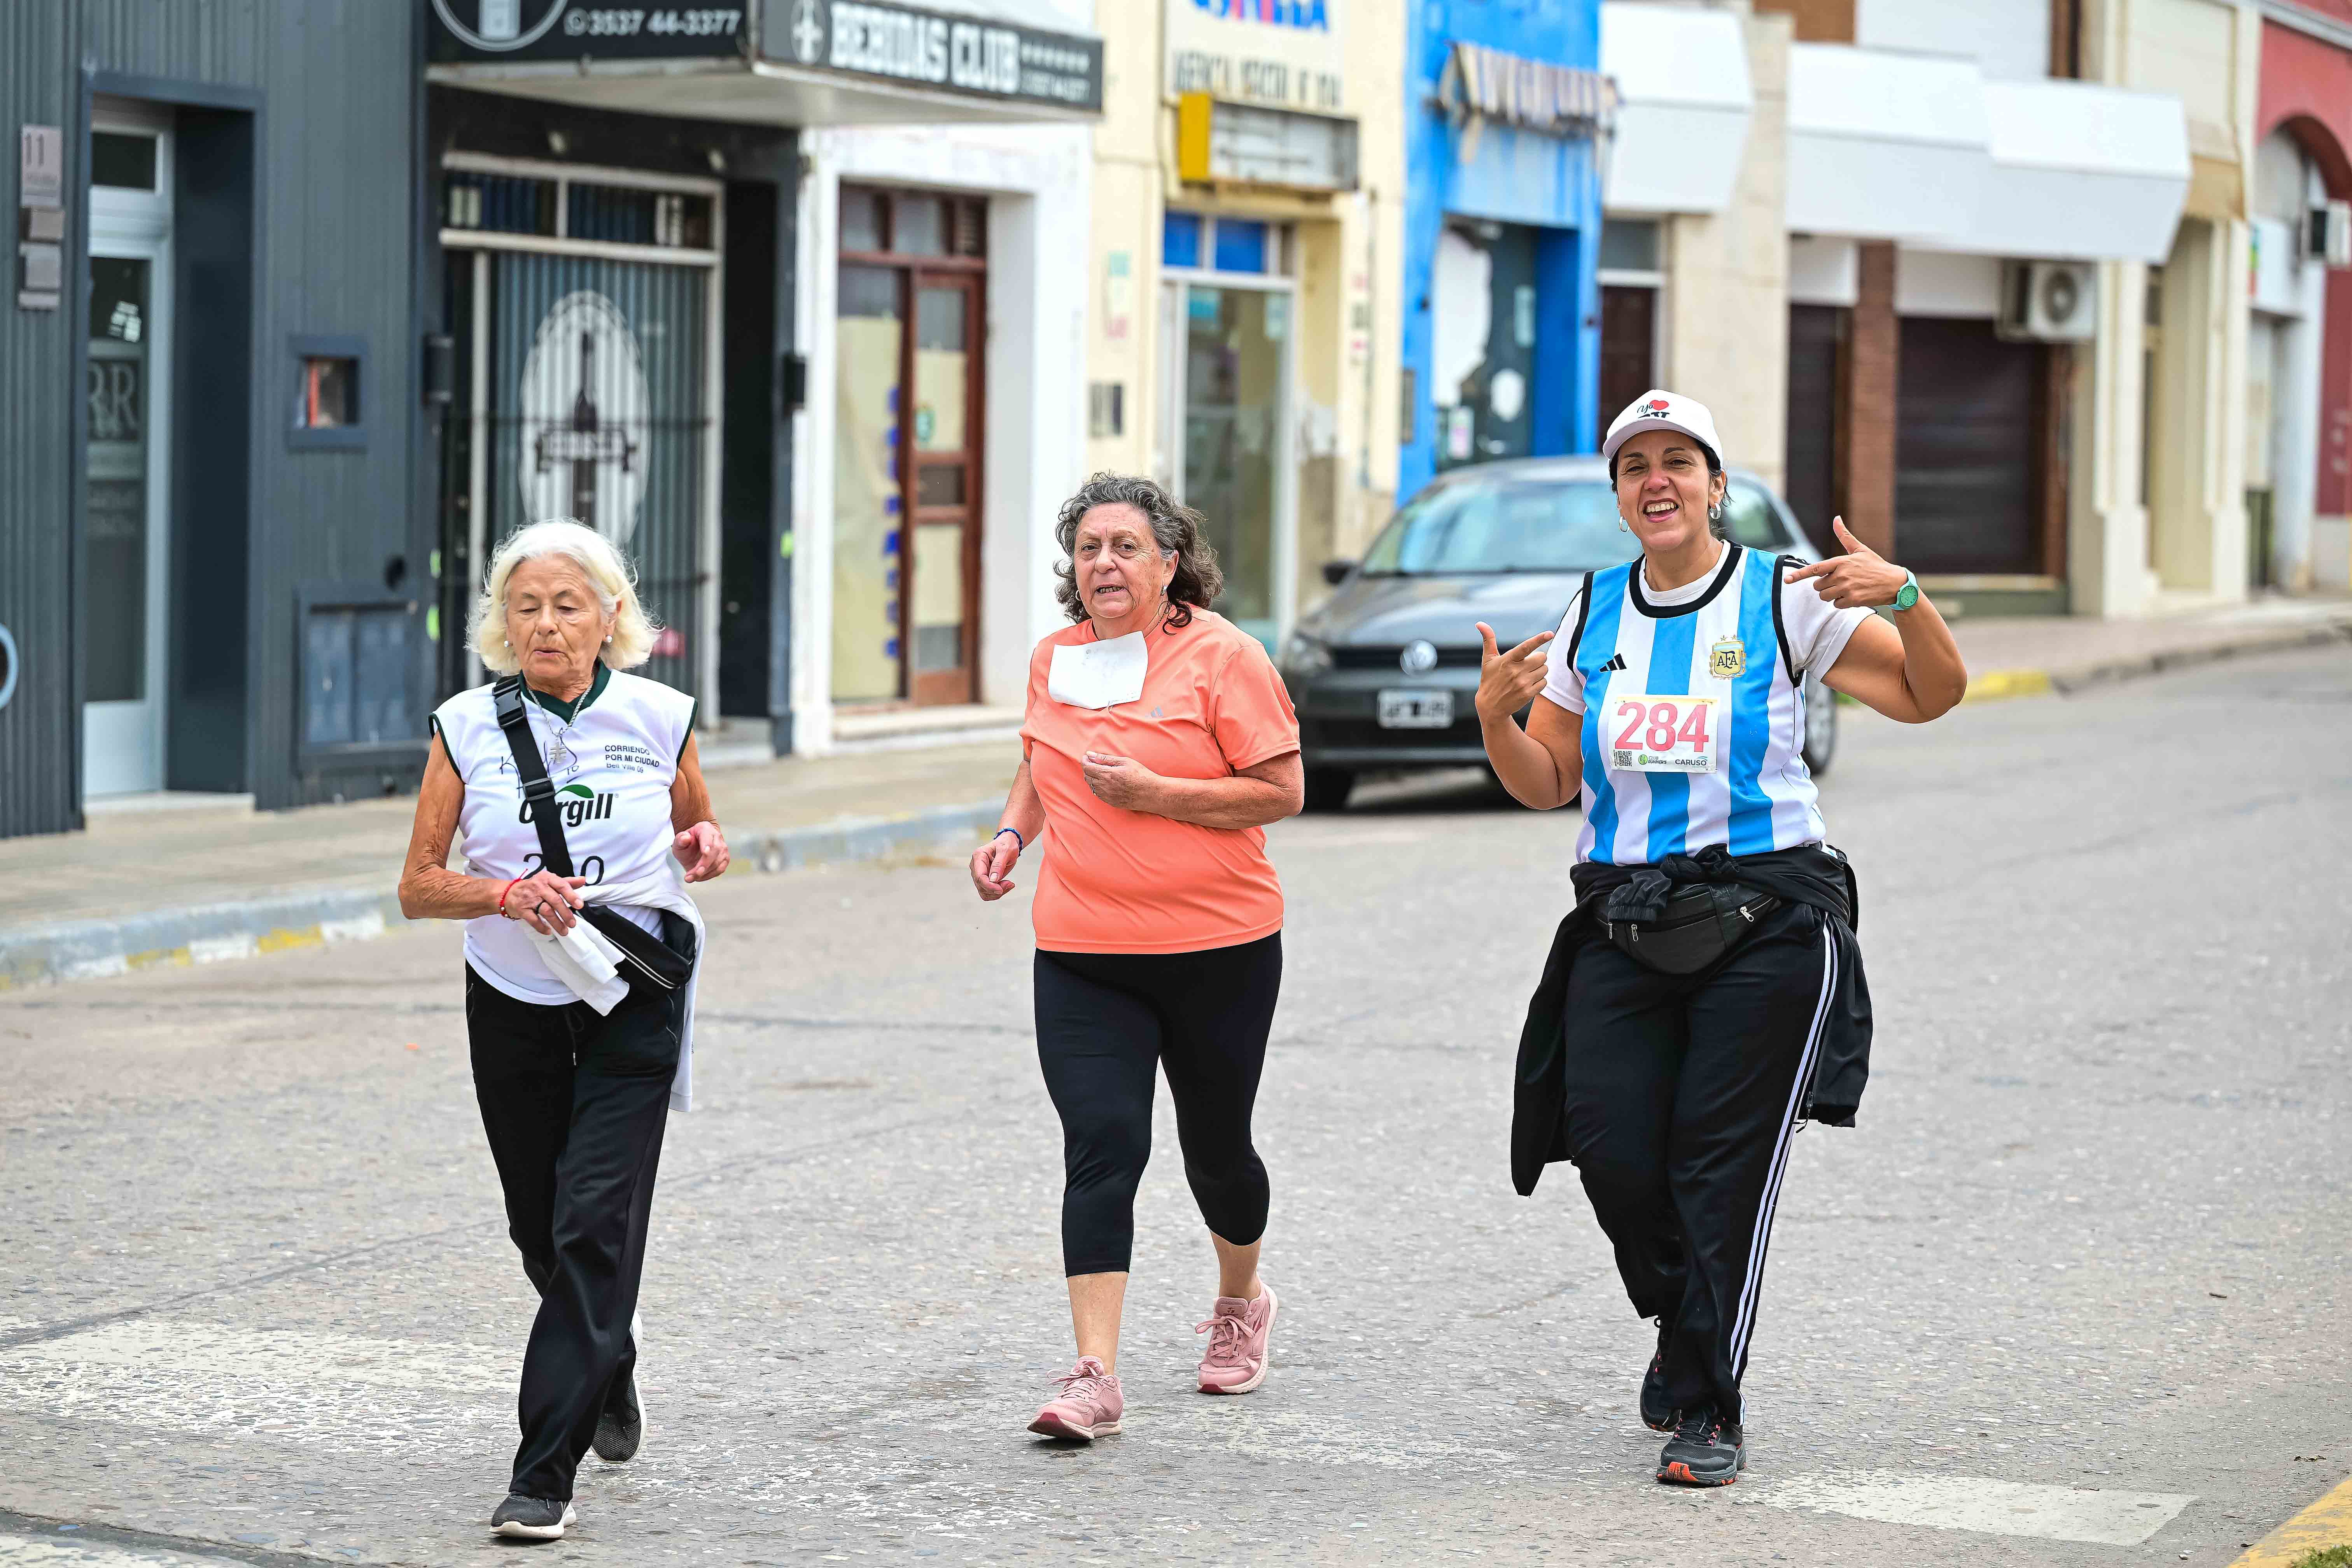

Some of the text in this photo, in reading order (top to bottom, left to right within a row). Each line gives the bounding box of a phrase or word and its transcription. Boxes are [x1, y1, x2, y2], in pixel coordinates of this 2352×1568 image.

[1717, 651, 1738, 669] AFA
[1615, 702, 1709, 752] 284
[605, 745, 650, 755] CORRIENDO
[635, 756, 660, 767] CIUDAD
[519, 793, 613, 827] Crgill
[523, 853, 604, 887] 20
